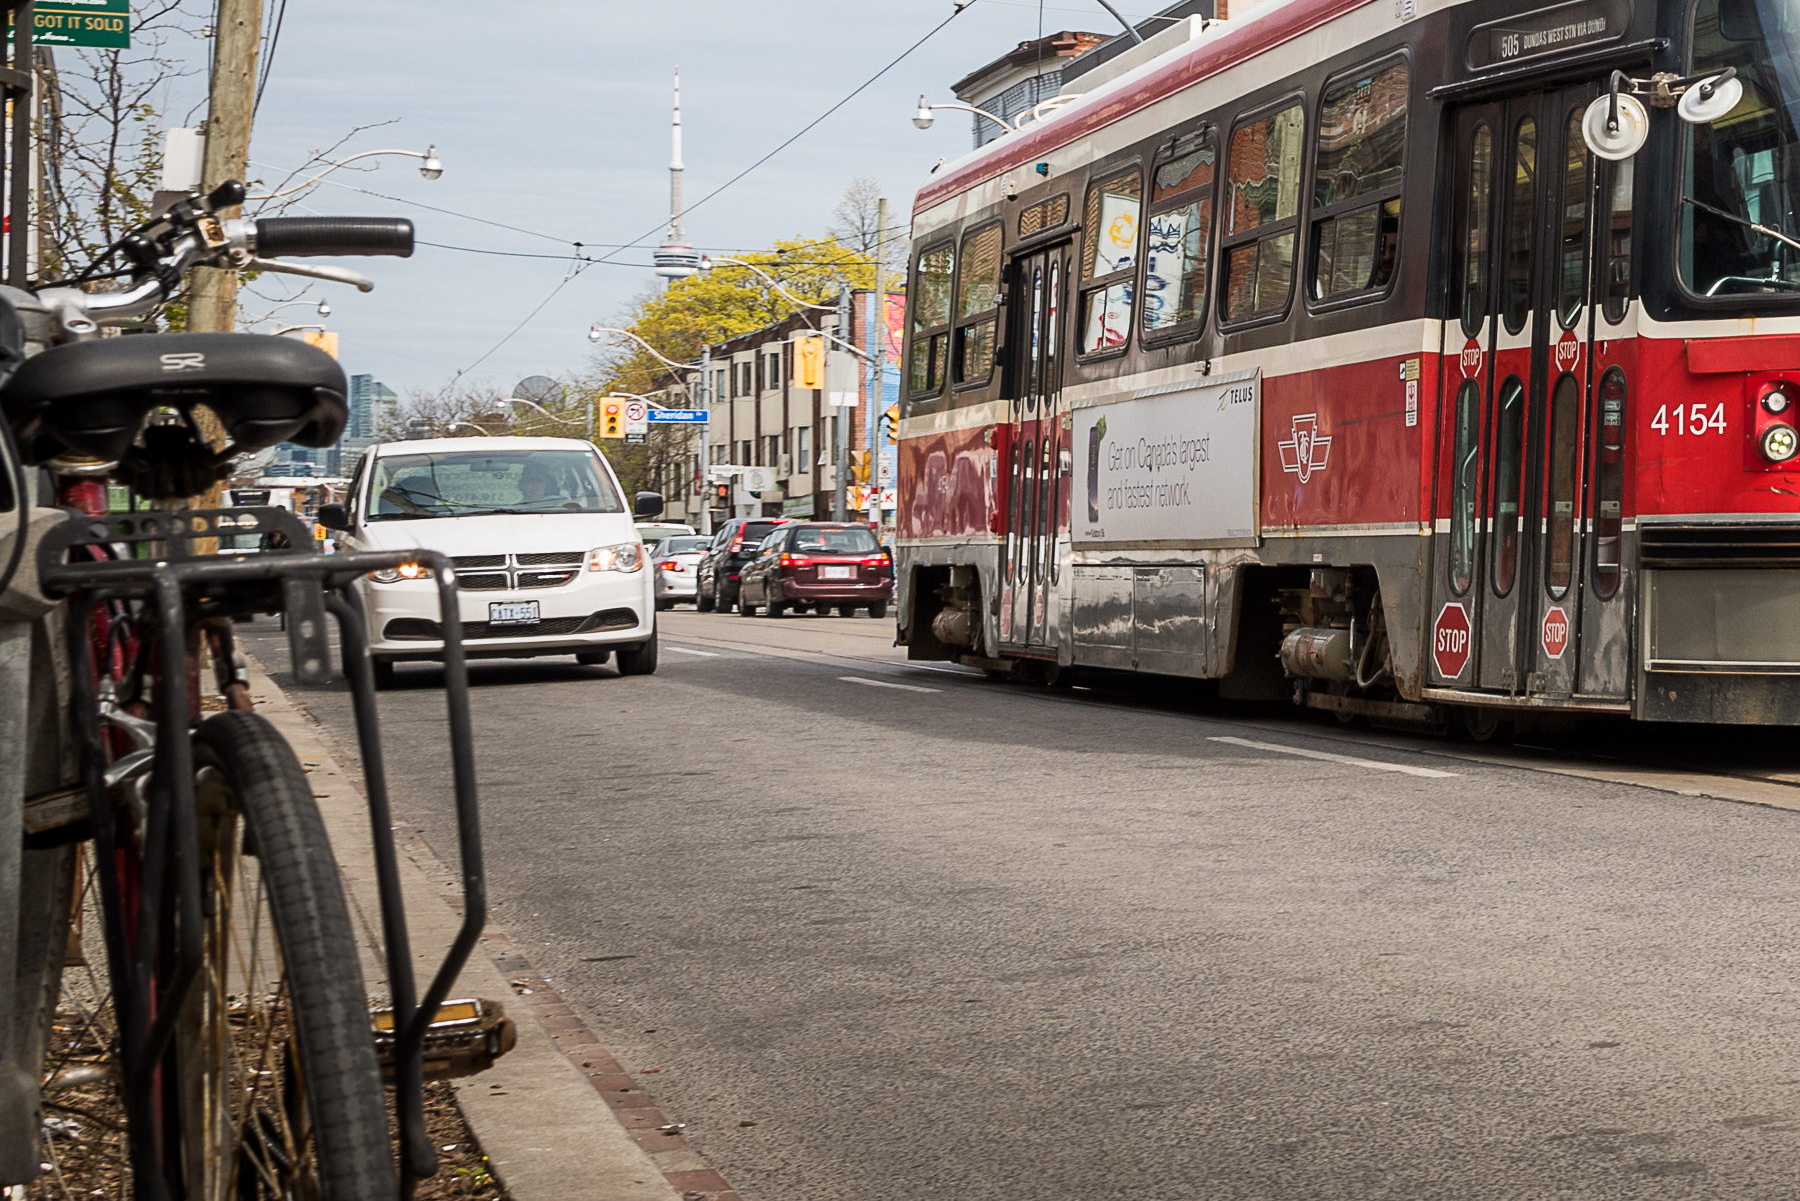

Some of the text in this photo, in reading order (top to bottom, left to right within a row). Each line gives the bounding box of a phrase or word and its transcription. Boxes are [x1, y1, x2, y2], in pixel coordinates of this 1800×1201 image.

[34, 15, 124, 31] GOT IT SOLD
[1501, 33, 1519, 58] 505
[1523, 31, 1547, 49] DUNDAS
[1548, 27, 1564, 44] WEST
[1565, 24, 1577, 40] STN
[1577, 21, 1587, 37] VIA
[1463, 348, 1479, 367] STOP
[1559, 341, 1577, 360] STOP
[1230, 387, 1253, 404] TELUS
[654, 410, 694, 420] Sheridan
[1651, 402, 1727, 436] 4154
[1108, 441, 1123, 471] Get
[1125, 446, 1136, 469] on
[1137, 434, 1177, 469] Canada's
[1180, 432, 1210, 471] largest
[1108, 475, 1191, 509] and fastest network.
[1438, 629, 1467, 653] STOP
[1545, 623, 1565, 643] STOP
